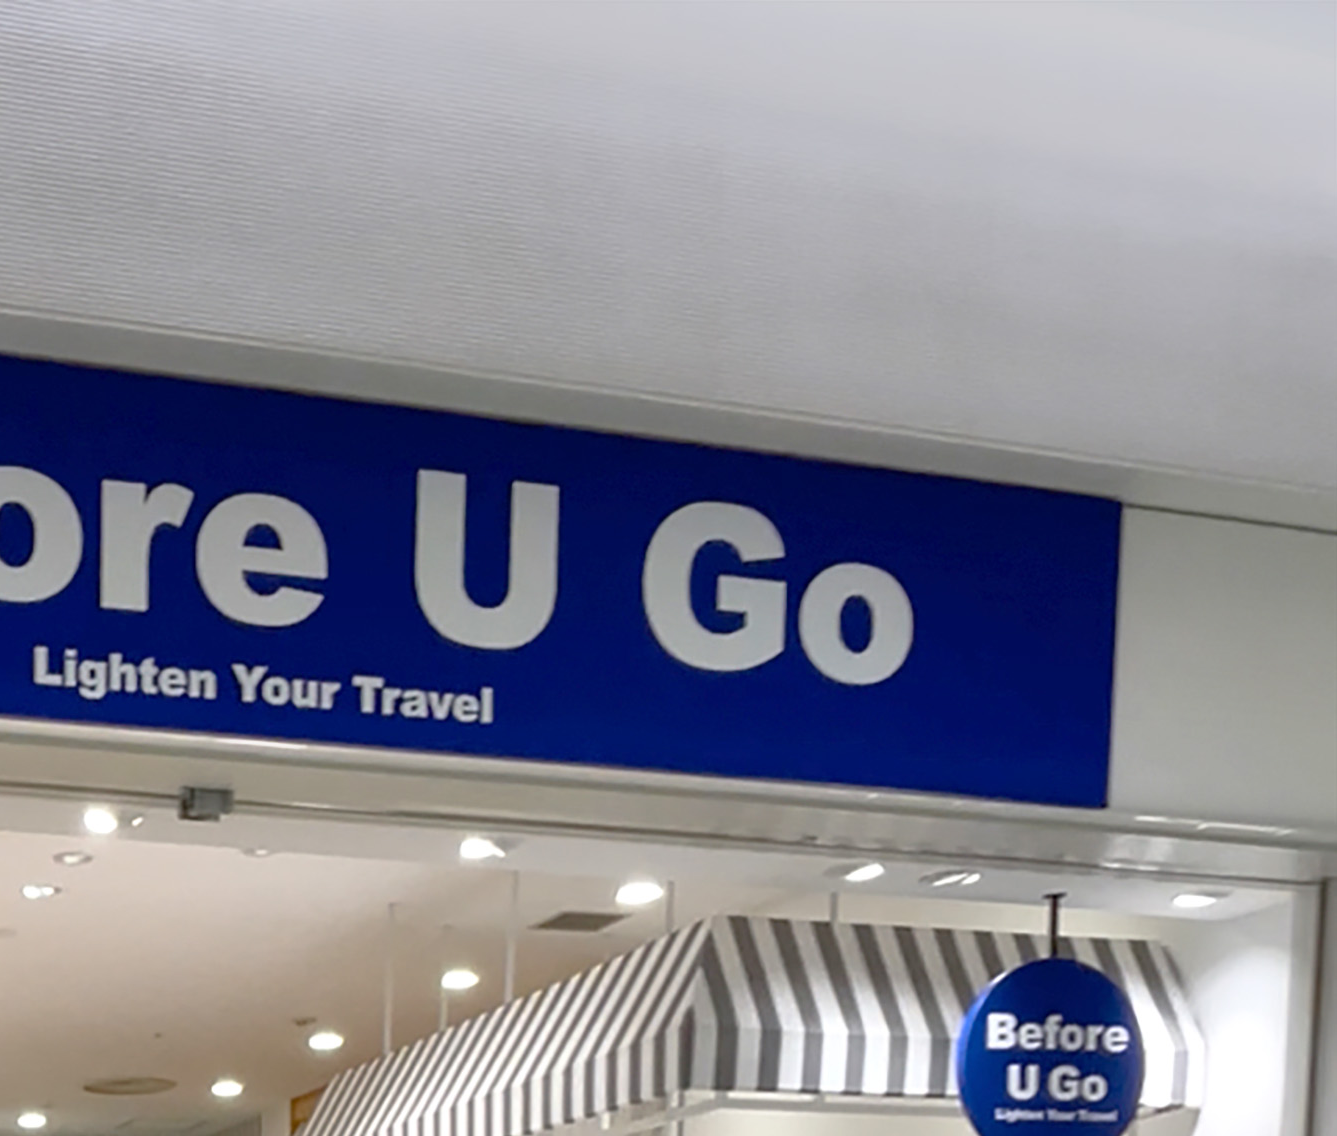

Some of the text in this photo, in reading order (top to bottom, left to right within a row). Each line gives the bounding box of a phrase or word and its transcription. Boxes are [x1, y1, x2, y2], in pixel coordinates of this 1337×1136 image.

[415, 469, 560, 650] U
[642, 500, 915, 687] Go
[33, 645, 494, 724] Lighten Your Travel
[986, 1012, 1130, 1053] Before
[1006, 1063, 1108, 1102] U Go
[994, 1107, 1044, 1123] Lighten
